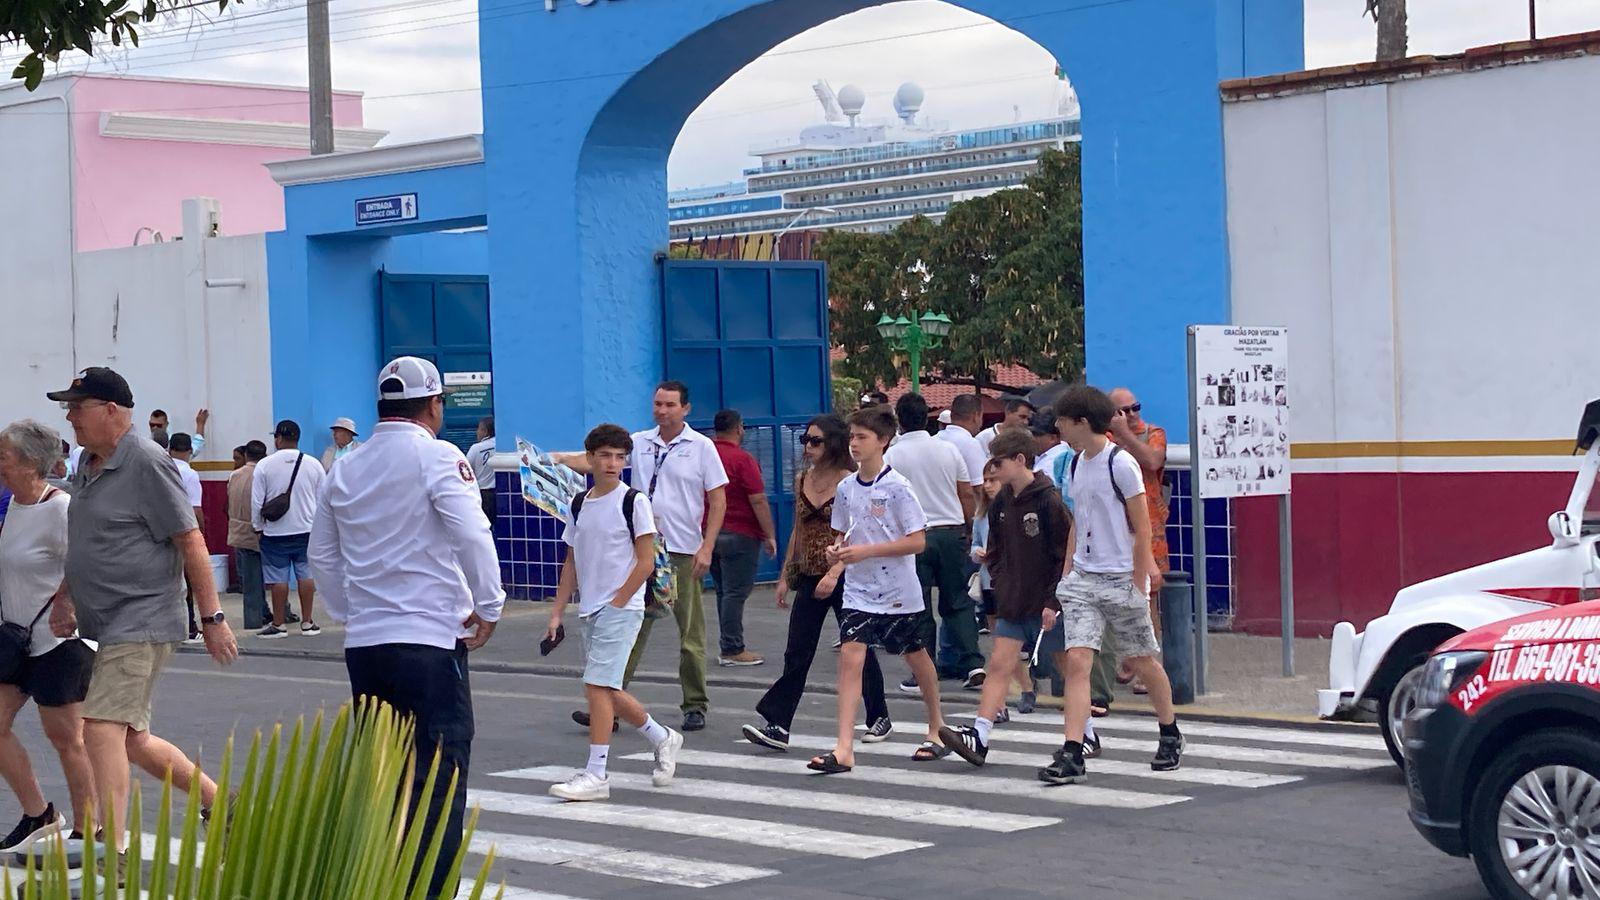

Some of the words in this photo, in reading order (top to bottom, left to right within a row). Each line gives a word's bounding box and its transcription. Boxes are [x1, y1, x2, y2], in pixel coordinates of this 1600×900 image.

[365, 201, 393, 211] ENTRADA
[386, 208, 400, 216] ONLY
[1500, 617, 1562, 642] SERVICIO
[1552, 617, 1572, 640] A
[1488, 643, 1516, 682] TEL
[1512, 642, 1600, 684] 669-981-35
[1458, 674, 1488, 712] 242
